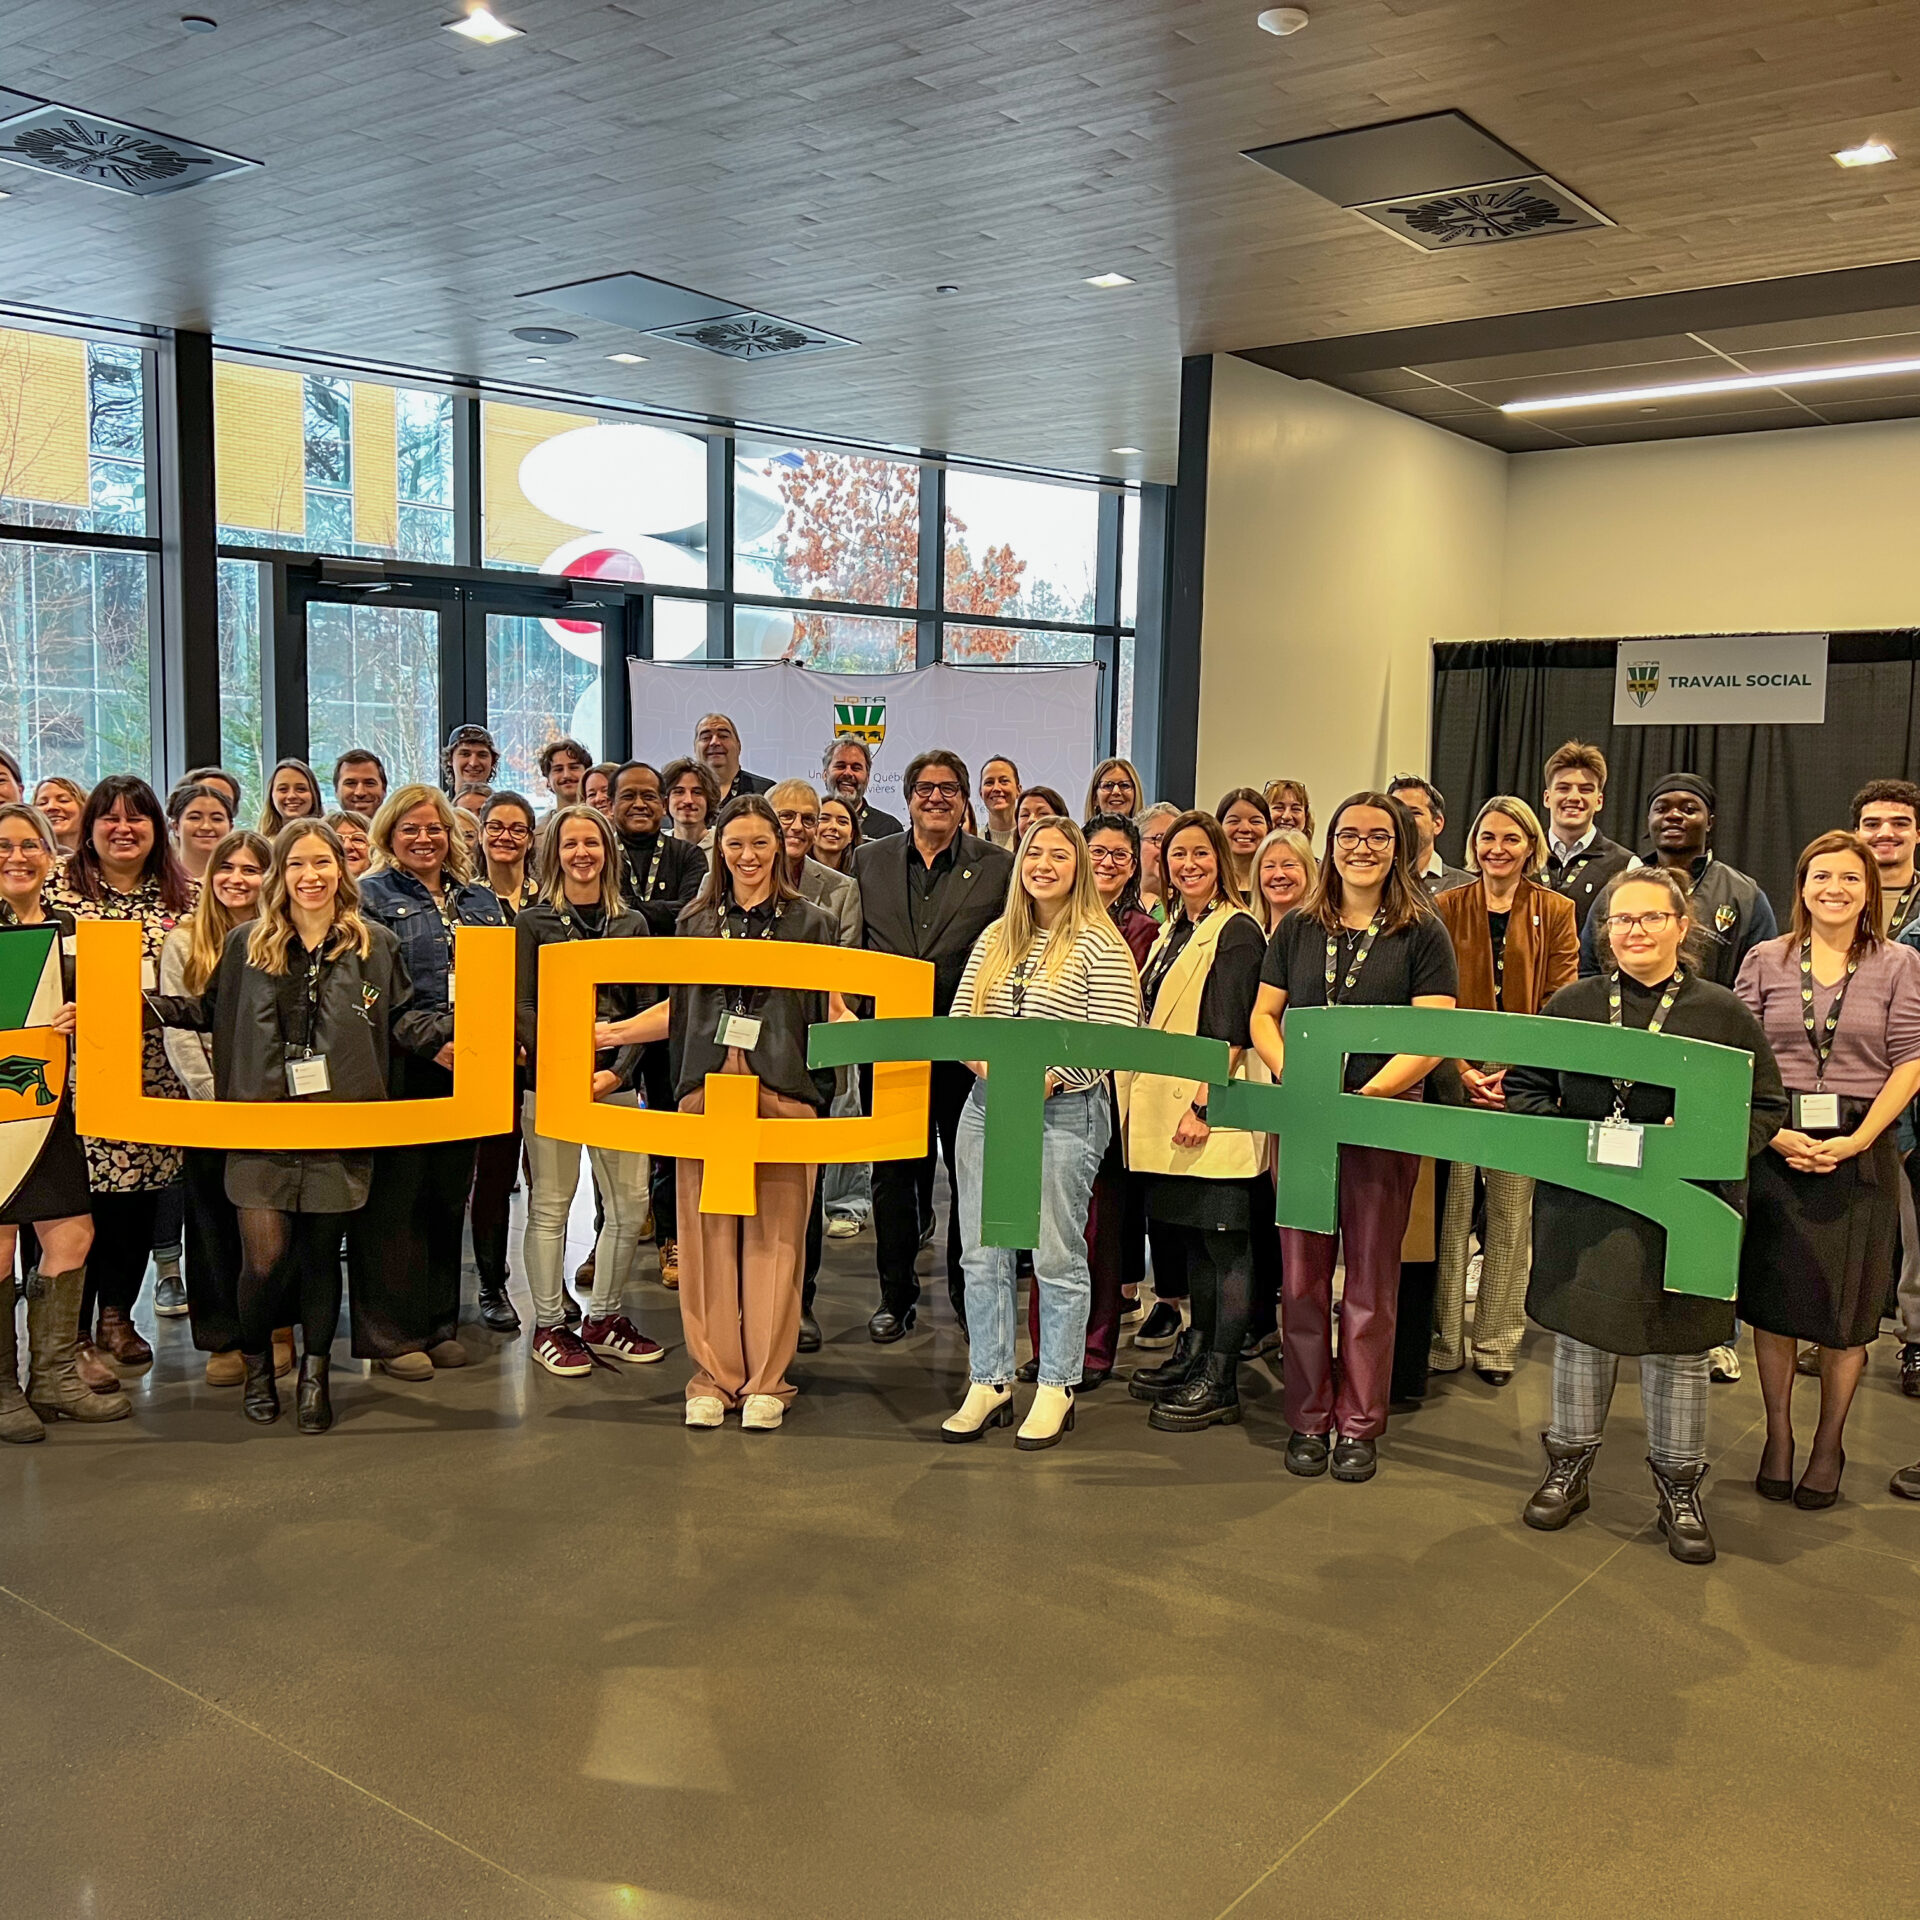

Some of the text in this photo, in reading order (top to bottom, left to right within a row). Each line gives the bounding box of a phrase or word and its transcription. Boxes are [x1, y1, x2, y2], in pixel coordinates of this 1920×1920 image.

[1668, 674, 1812, 688] TRAVAIL SOCIAL
[834, 695, 886, 704] UQTR
